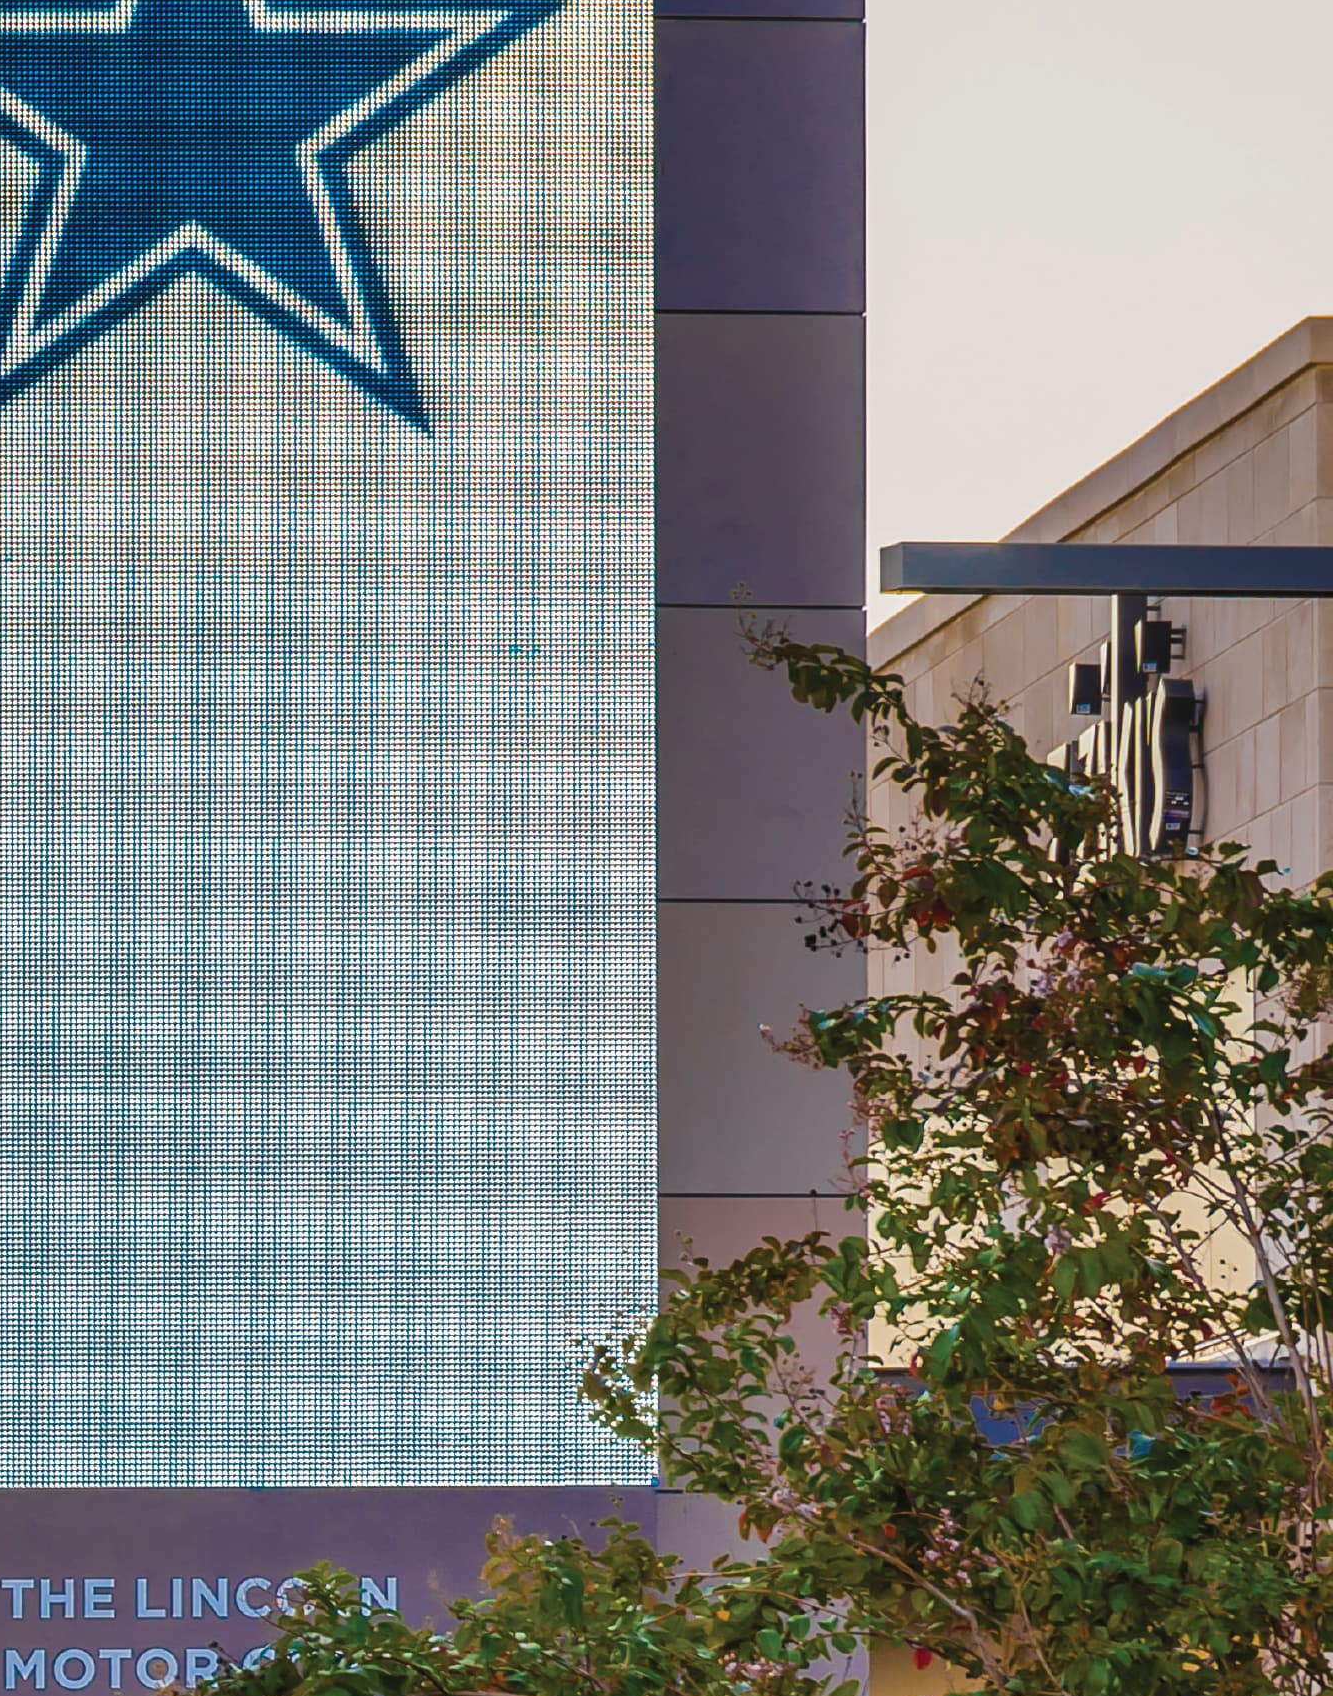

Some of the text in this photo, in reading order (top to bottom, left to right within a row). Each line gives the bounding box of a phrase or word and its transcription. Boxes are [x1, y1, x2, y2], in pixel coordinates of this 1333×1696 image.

[0, 1575, 399, 1619] THE LINCON
[3, 1646, 221, 1691] MOTOR
